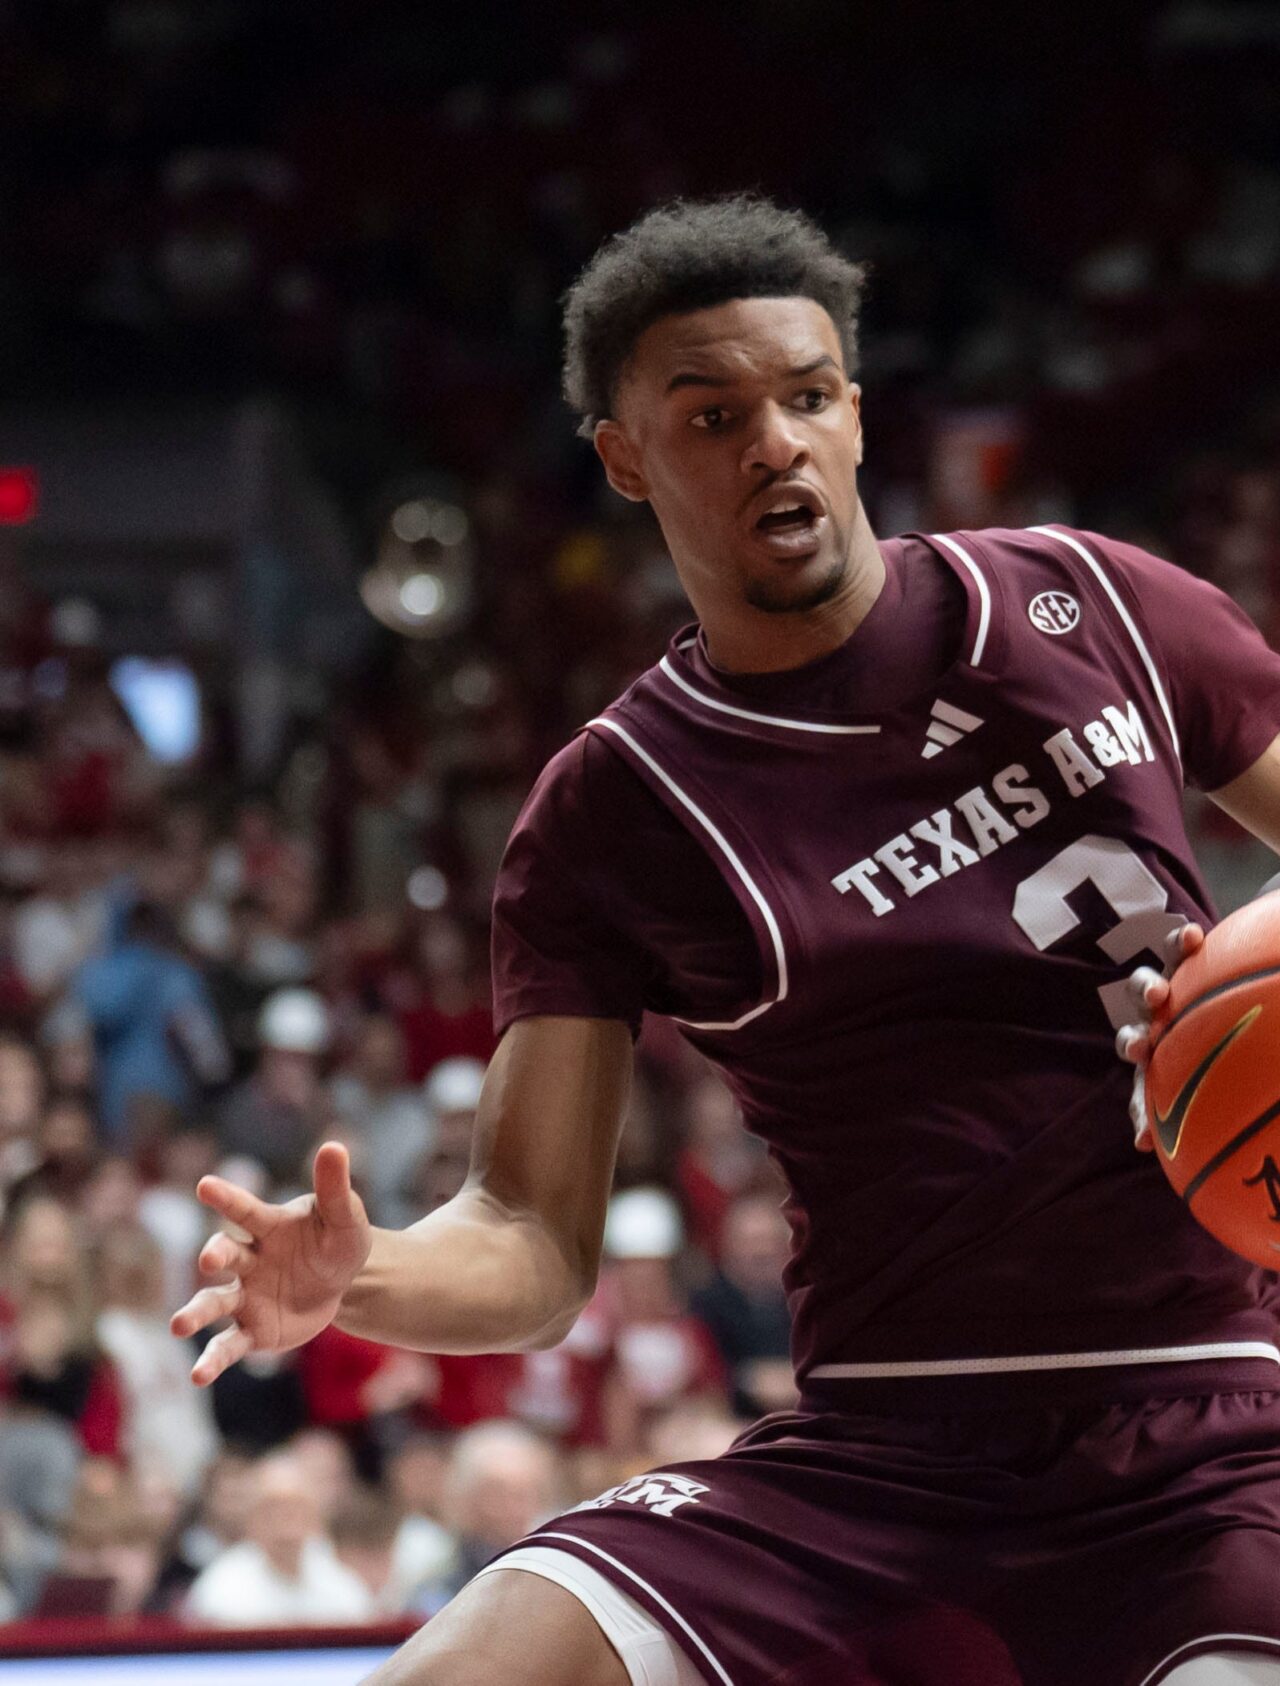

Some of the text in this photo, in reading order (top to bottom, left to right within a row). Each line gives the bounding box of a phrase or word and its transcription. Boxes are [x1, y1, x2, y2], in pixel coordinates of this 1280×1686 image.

[1032, 592, 1078, 631] SEC
[831, 701, 1155, 917] TEXAS A&M
[1012, 833, 1190, 1033] 3
